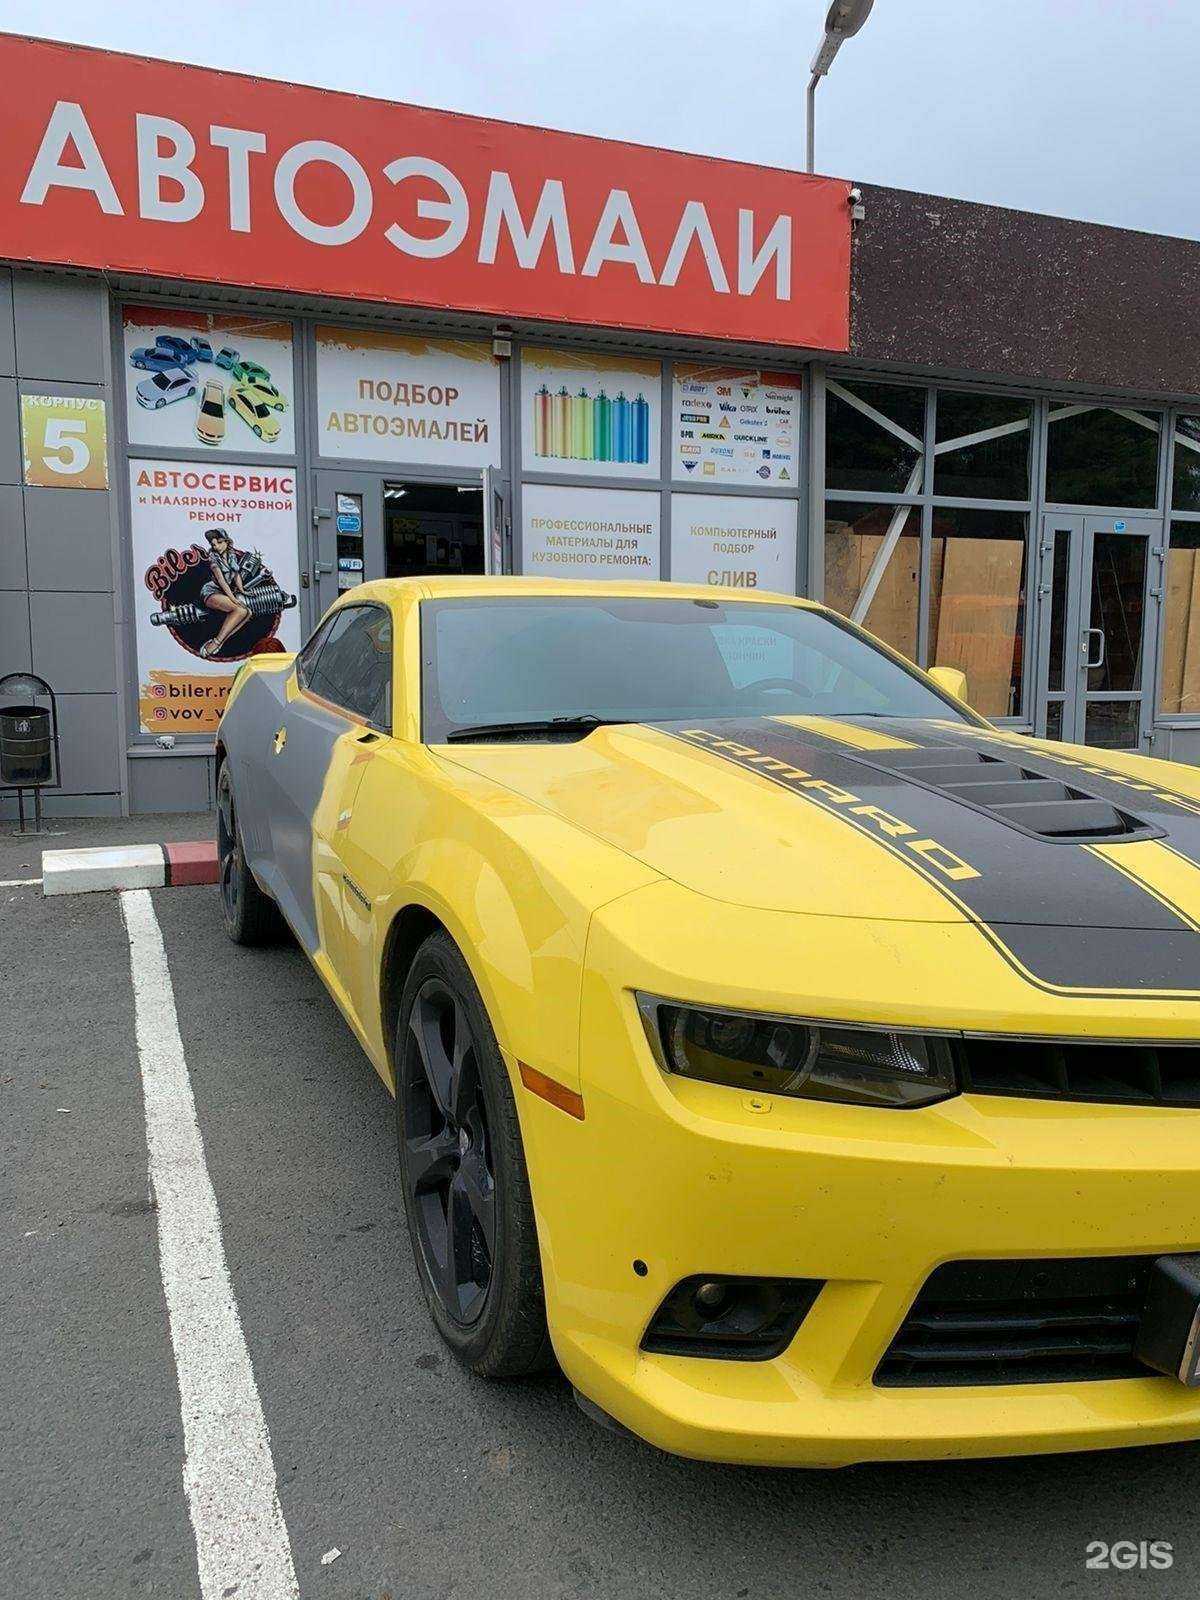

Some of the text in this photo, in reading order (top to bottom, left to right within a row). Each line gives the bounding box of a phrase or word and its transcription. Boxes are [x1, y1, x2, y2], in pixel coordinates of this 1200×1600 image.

[20, 100, 793, 302] АВТОЭМАЛИ
[358, 379, 460, 407] ПОДБОР
[716, 385, 732, 397] 3M
[28, 395, 99, 410] КОРПУС
[326, 411, 489, 444] АВТОЭМАЛЕЙ
[42, 418, 91, 475] 5
[733, 434, 768, 443] QUICKLINE
[136, 470, 294, 494] АВТОСЕРВИС
[151, 494, 293, 511] МАЛЯРНО-КУЗОВНОЙ
[188, 511, 243, 523] РЕМОНТ
[531, 518, 653, 534] ПРОФЕССИОНАЛЬНЫЕ
[690, 527, 777, 540] КОМПЬЮТЕРНЫЙ
[545, 536, 638, 550] МАТЕРИАЛЫ ДЛЯ
[713, 543, 755, 554] ПОДБОР
[531, 551, 653, 566] КУЗОВНОГО РЕМОНТА:
[707, 570, 758, 588] СЛИВ
[679, 728, 982, 881] CAMARO
